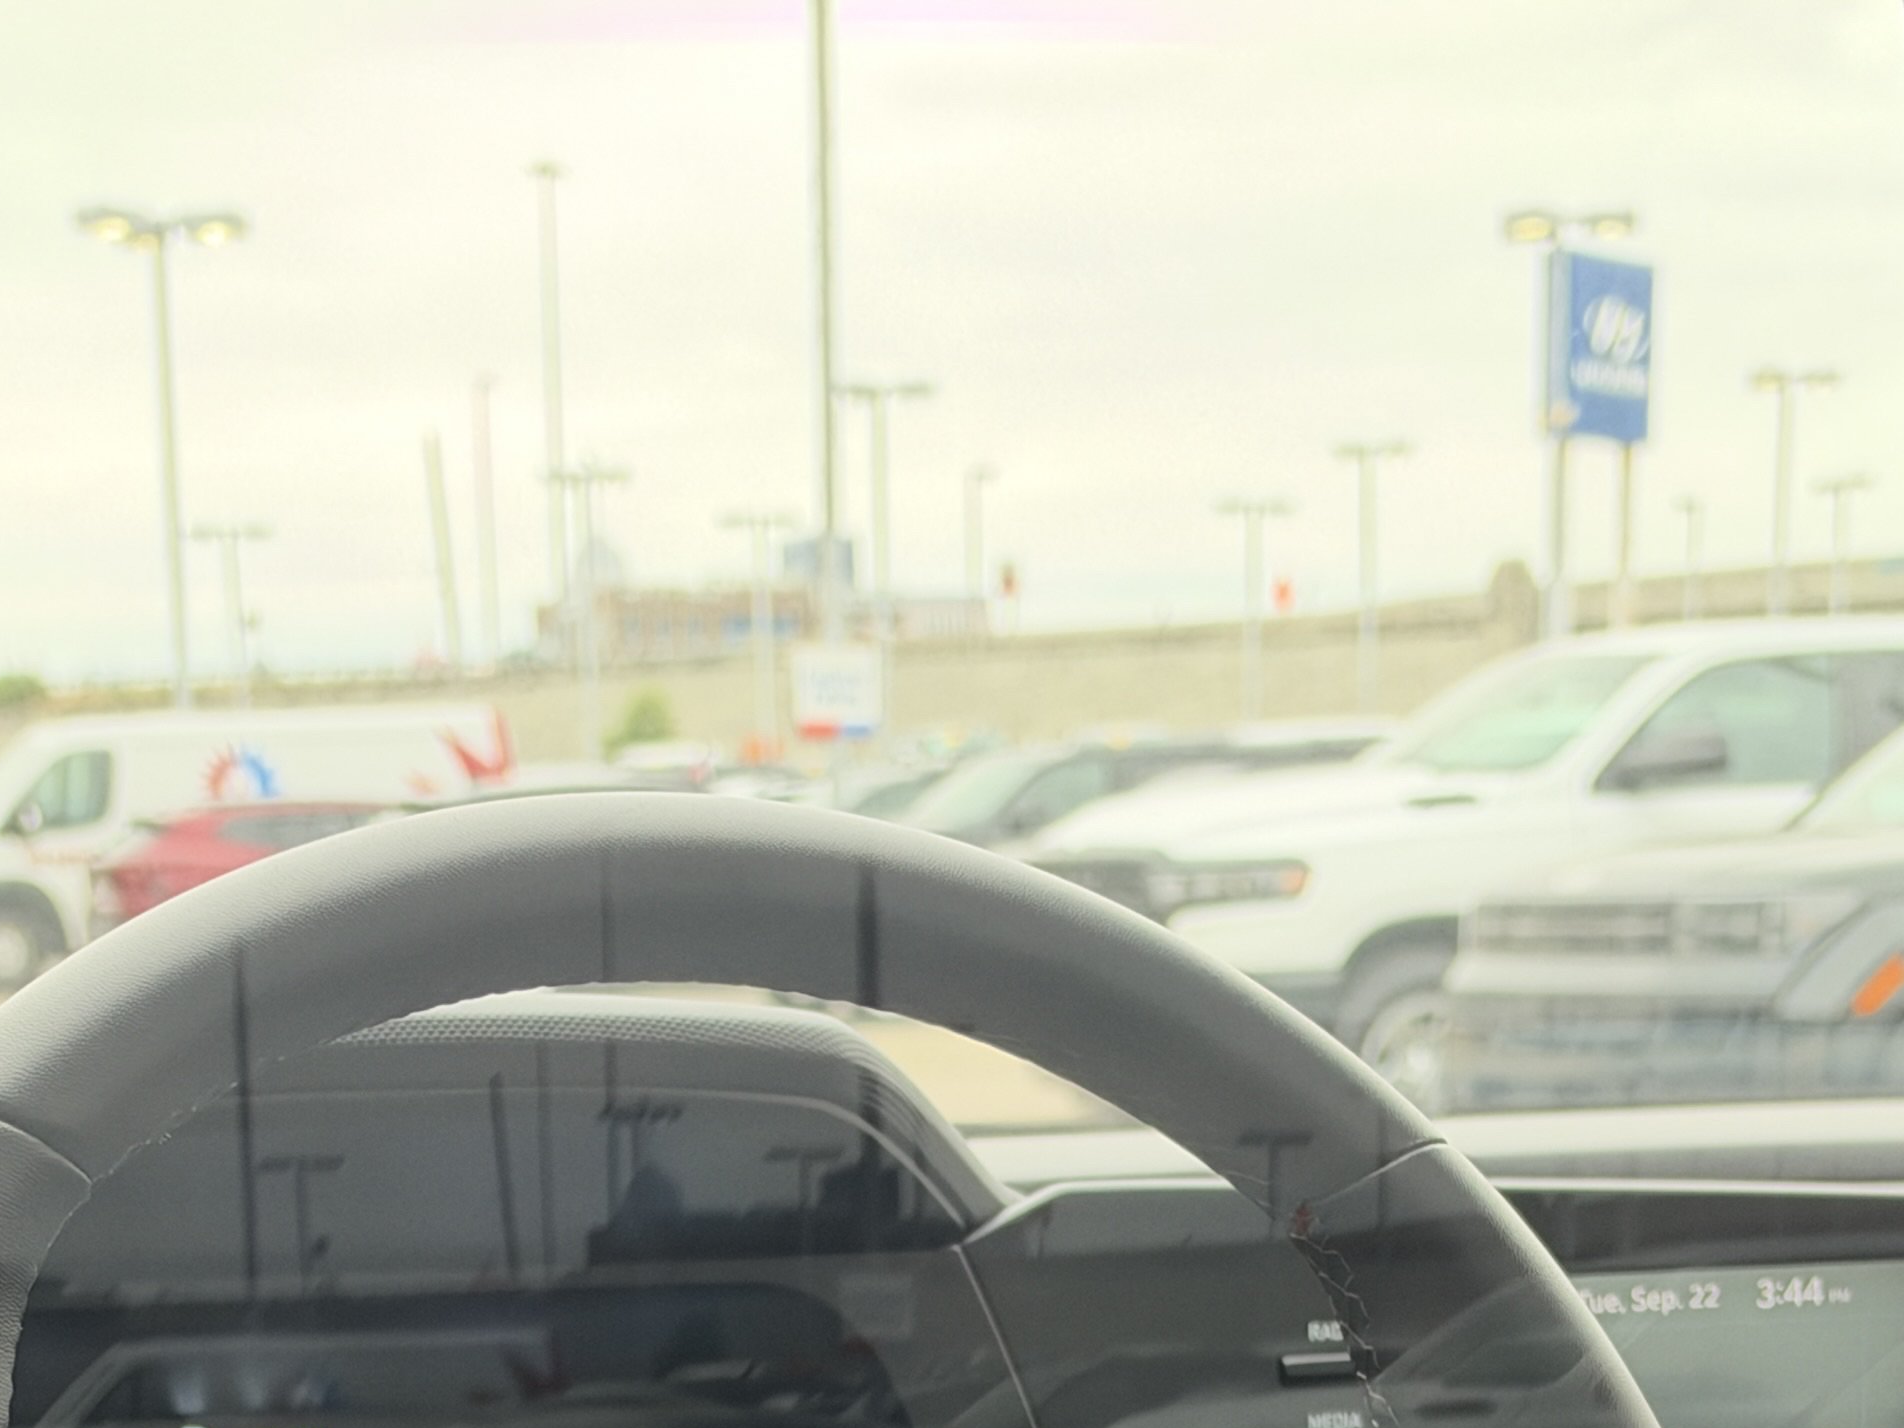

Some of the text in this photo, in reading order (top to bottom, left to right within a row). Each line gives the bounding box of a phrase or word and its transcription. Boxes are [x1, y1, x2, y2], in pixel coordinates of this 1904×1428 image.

[1631, 1283, 1684, 1316] Sep.
[1688, 1282, 1721, 1310] 22
[1755, 1275, 1825, 1310] 3:44
[1307, 1320, 1345, 1342] RAD
